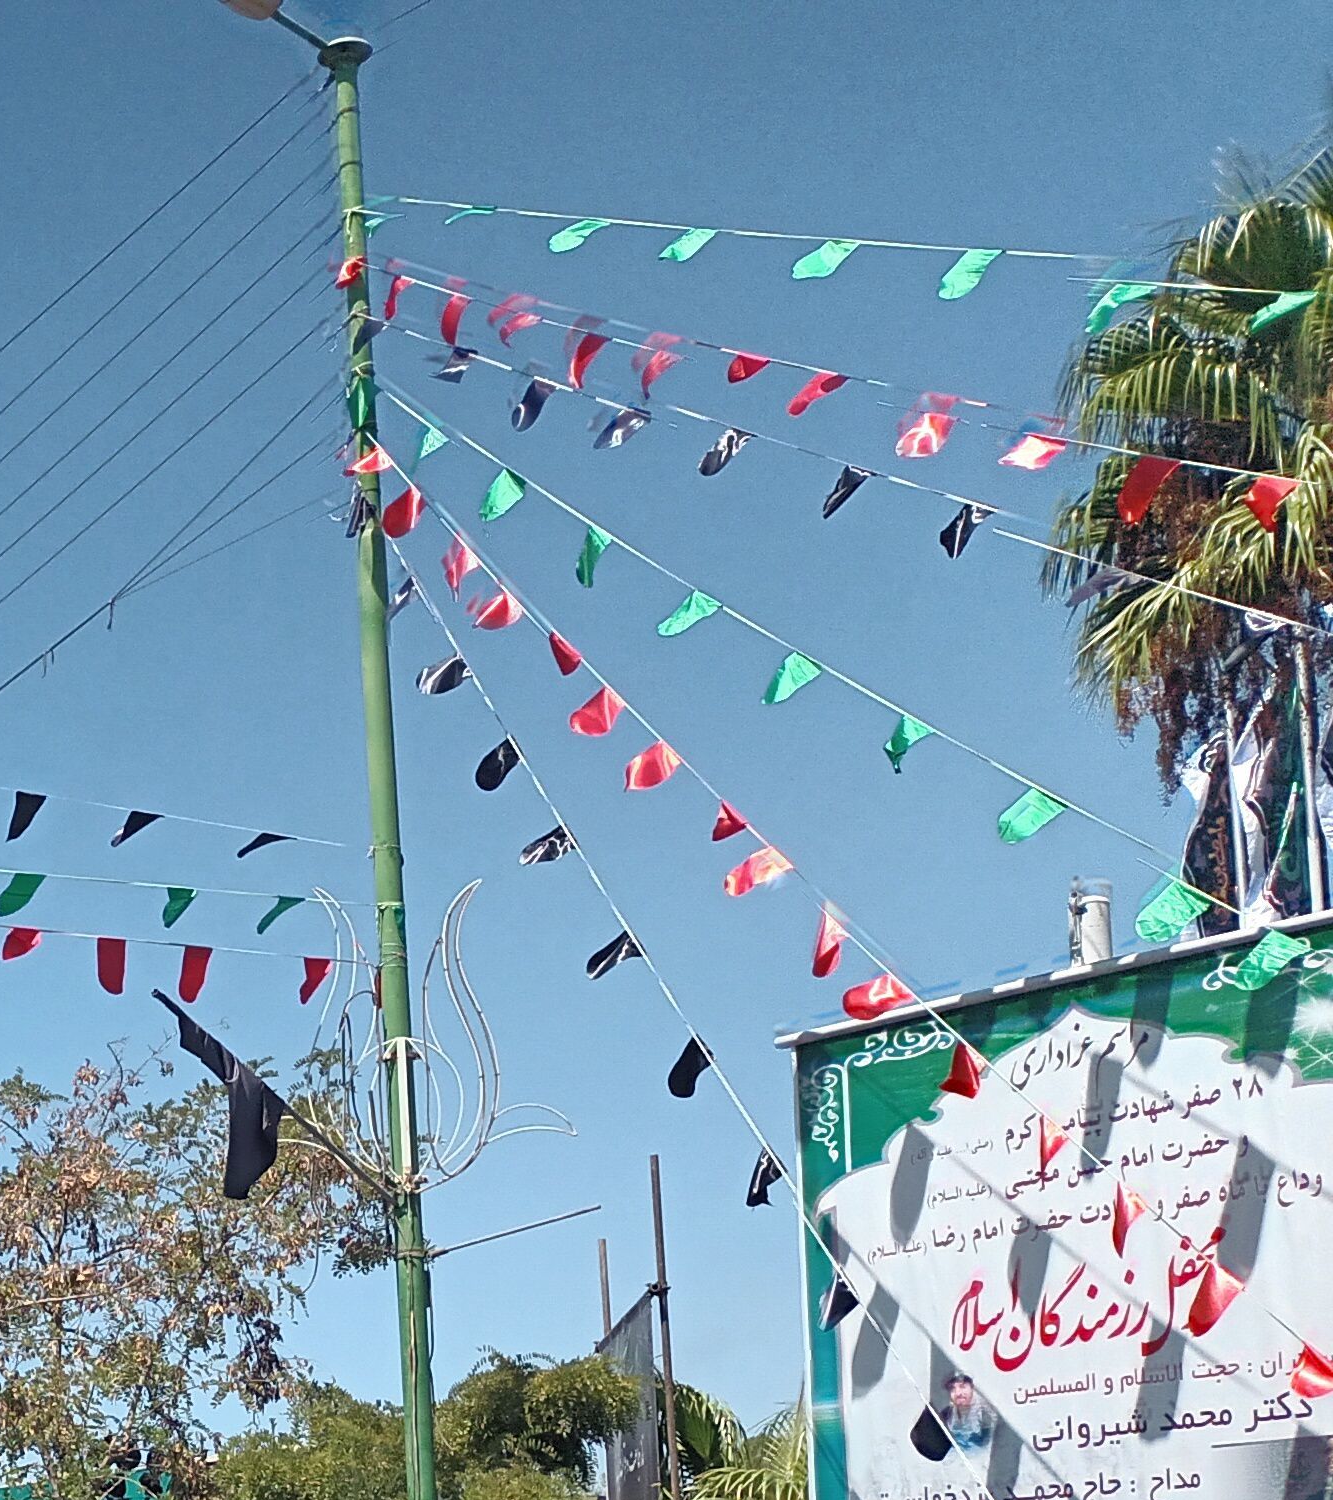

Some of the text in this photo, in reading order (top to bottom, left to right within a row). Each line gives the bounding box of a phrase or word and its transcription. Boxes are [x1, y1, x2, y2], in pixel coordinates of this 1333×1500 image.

[1010, 1020, 1149, 1098] مراسم عزاداری
[1181, 1084, 1221, 1119] صفر
[1232, 1074, 1264, 1099] ۲۸
[1061, 1108, 1101, 1136] پیام
[1109, 1090, 1174, 1123] شهادت
[1005, 1113, 1038, 1154] کرم
[926, 1133, 1248, 1209] و حضرت امام حسن مجتبی (علیه السلام)
[1169, 1185, 1211, 1220] صفر
[1219, 1178, 1245, 1202] ماه
[1277, 1169, 1323, 1208] وداع
[1011, 1209, 1073, 1242] حضرت
[1154, 1199, 1163, 1221] و
[931, 1225, 966, 1252] رضا
[972, 1218, 1004, 1254] امام
[951, 1255, 1021, 1351] اسلام
[993, 1262, 1150, 1372] رزمندگان
[1013, 1372, 1096, 1405] المسلمین
[1104, 1377, 1114, 1395] و
[1120, 1364, 1183, 1394] الاسلام
[1191, 1362, 1241, 1384] حجت
[1032, 1391, 1313, 1451] دکتر محمد شیروانی
